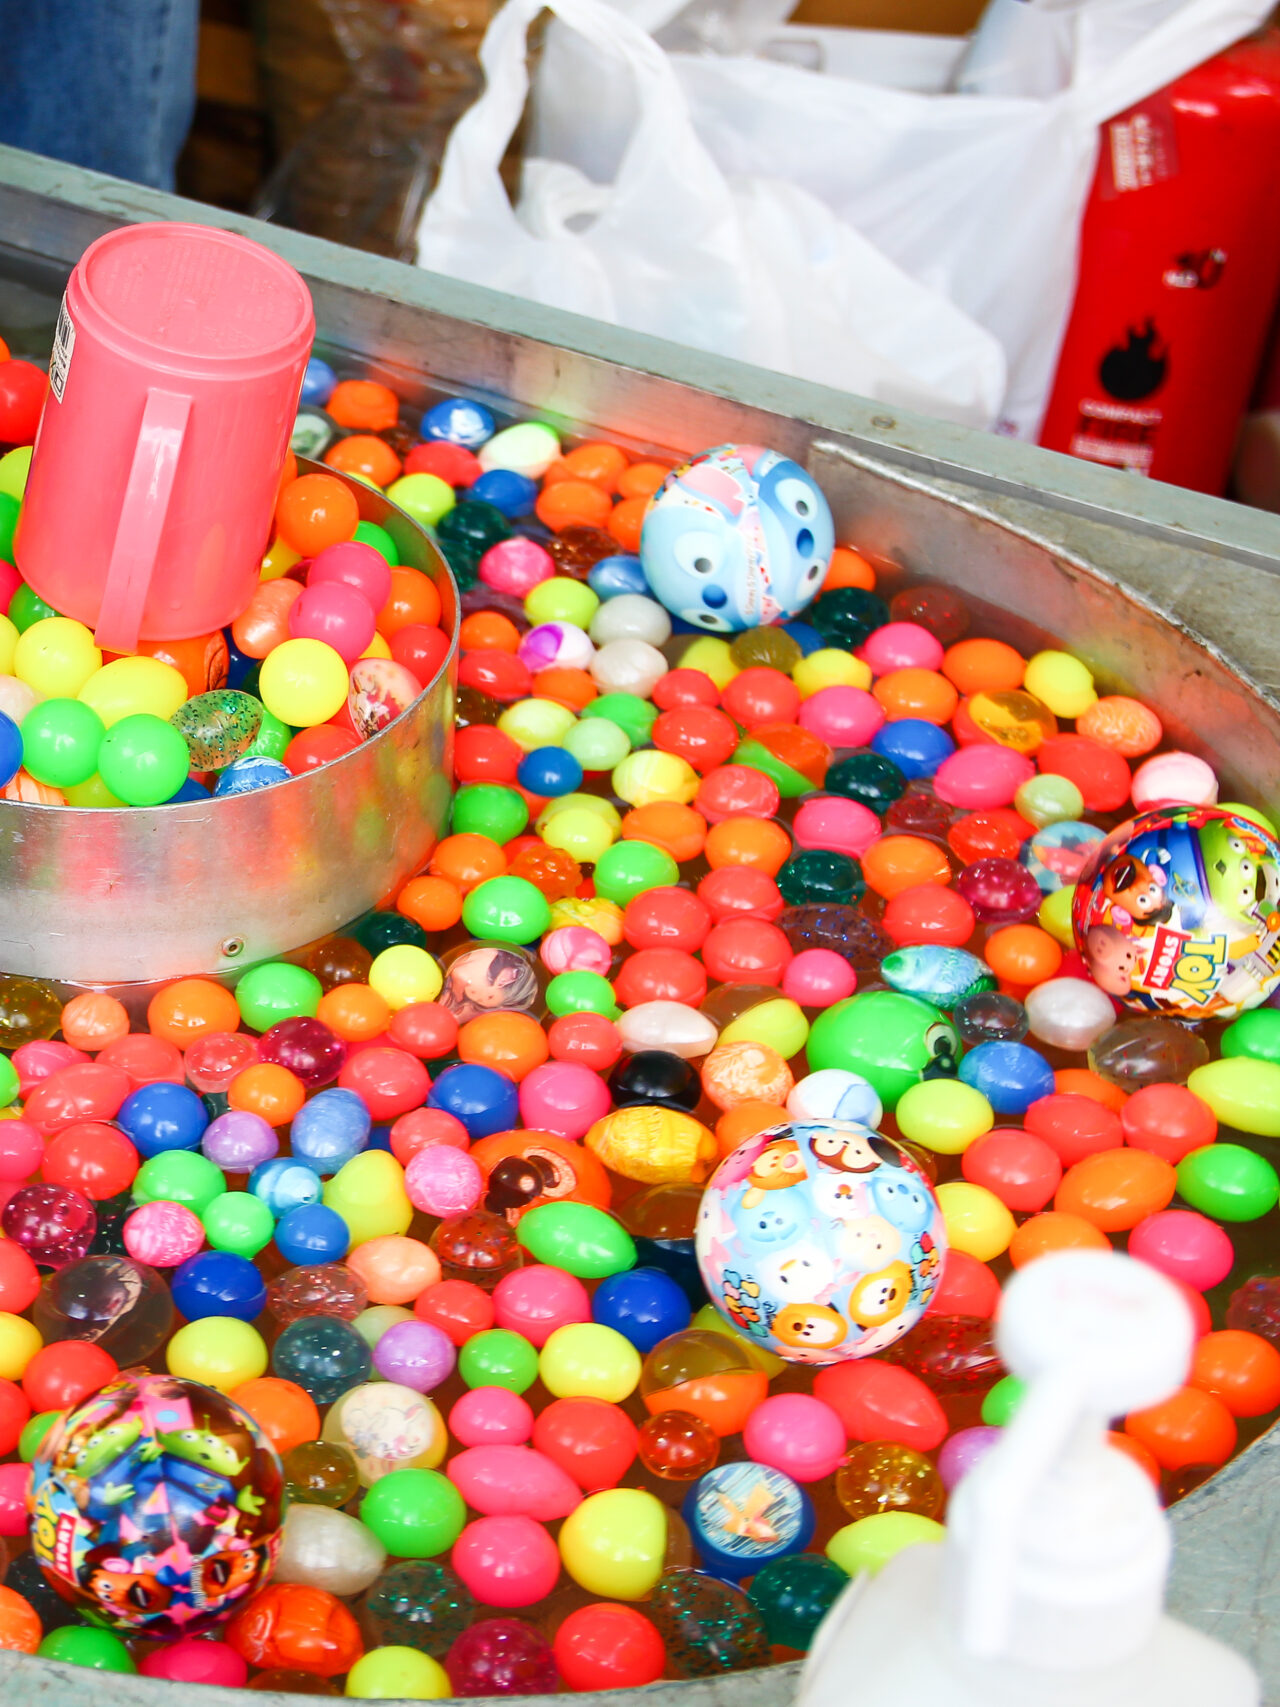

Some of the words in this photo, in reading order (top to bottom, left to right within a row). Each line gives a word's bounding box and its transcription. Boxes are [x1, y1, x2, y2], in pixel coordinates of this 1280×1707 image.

[1150, 935, 1179, 986] STORY
[1171, 934, 1228, 1005] TOY
[36, 1490, 58, 1561] TOY
[55, 1517, 73, 1574] STORY
